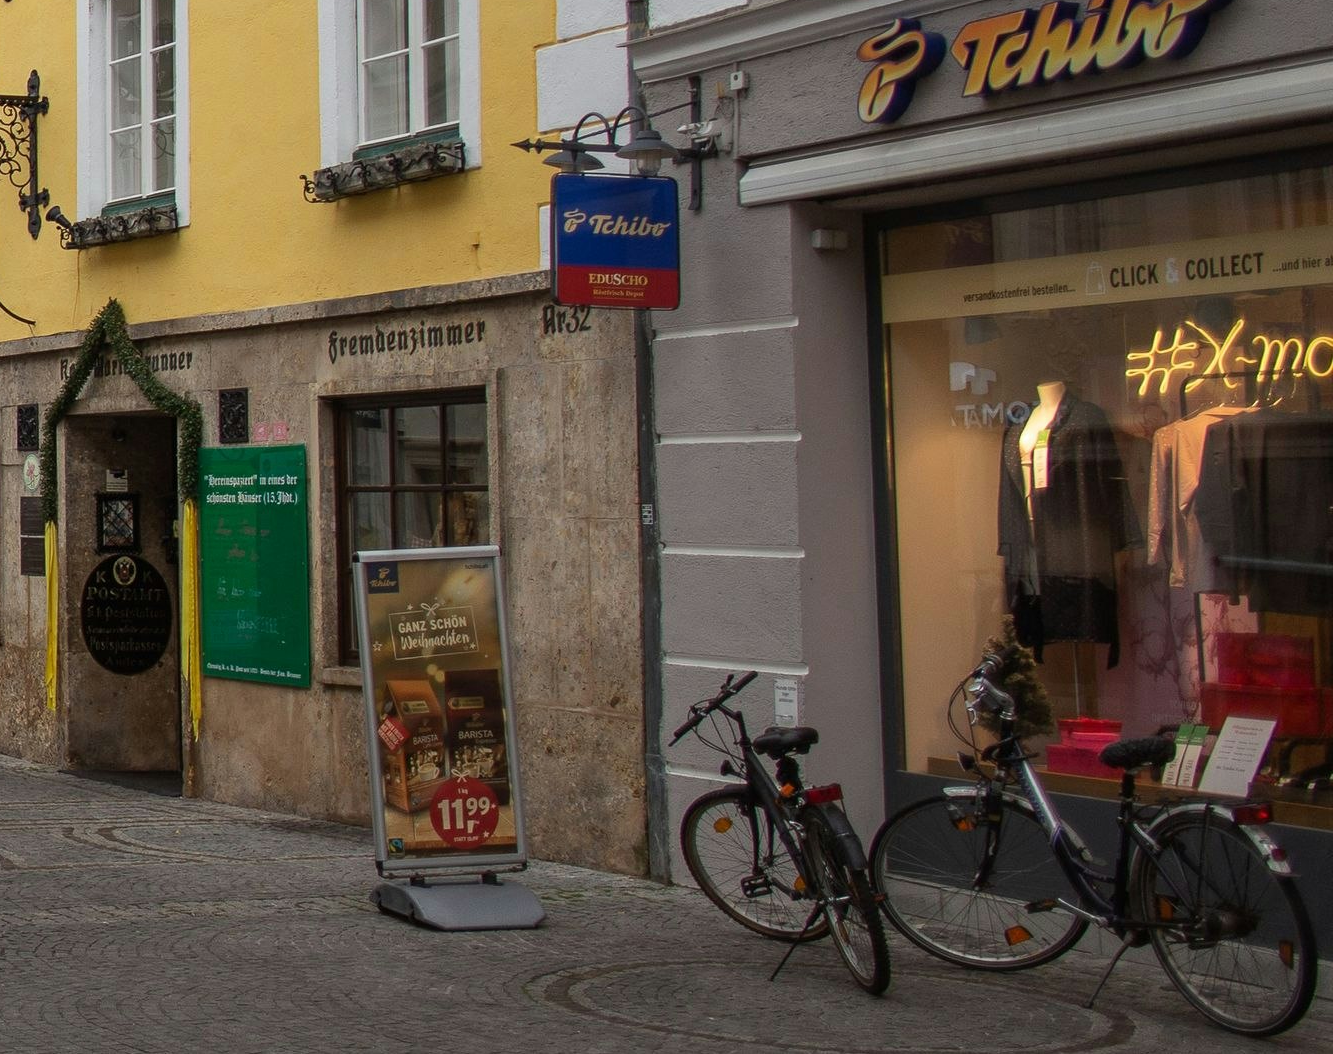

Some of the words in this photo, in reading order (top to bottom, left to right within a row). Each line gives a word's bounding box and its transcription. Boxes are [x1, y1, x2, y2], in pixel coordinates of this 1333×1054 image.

[588, 214, 672, 237] Tchibo
[588, 273, 649, 286] EDUSCHO
[963, 286, 1031, 303] versandkostenfrei
[1109, 263, 1159, 289] CLICK
[1165, 257, 1180, 284] &
[1185, 252, 1264, 281] COLLECT
[1302, 257, 1321, 269] hier
[259, 475, 266, 485] in
[268, 476, 285, 485] eines
[286, 474, 298, 485] der
[369, 578, 398, 587] Tchibo
[398, 620, 426, 633] GANZ
[430, 614, 467, 630] SCHÖN
[400, 629, 470, 651] Weihnachten
[412, 733, 439, 746] BARISTA
[458, 729, 494, 740] BARISTA
